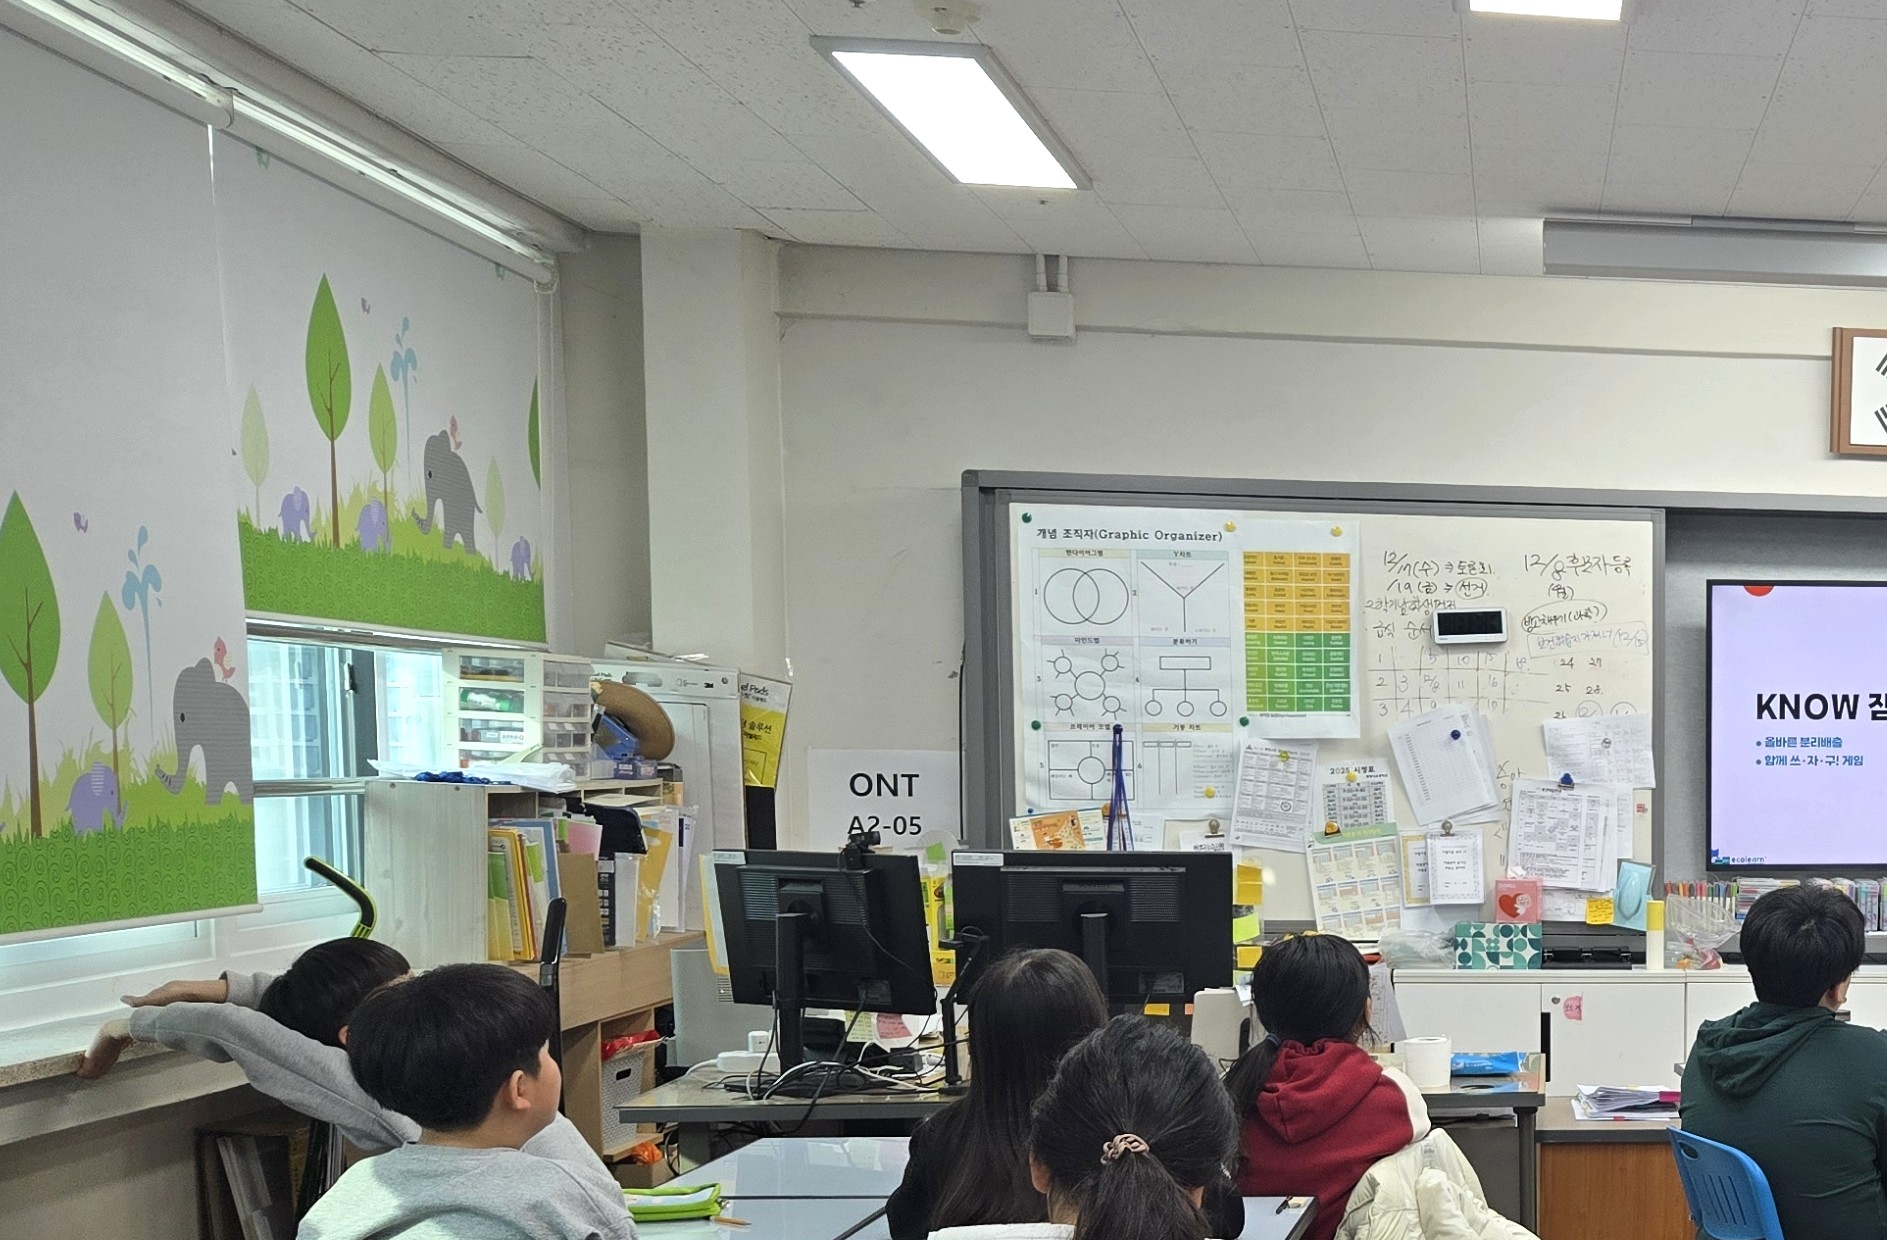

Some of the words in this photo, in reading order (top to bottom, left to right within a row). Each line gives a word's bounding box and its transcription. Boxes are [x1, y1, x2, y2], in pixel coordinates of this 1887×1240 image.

[1036, 528, 1057, 540] 개념
[1063, 528, 1149, 541] 조직자(Graphic
[1154, 530, 1223, 542] Organizer)
[1756, 693, 1860, 720] KNOW
[749, 719, 772, 735] 솔루션
[1764, 736, 1798, 748] 올바른
[1800, 736, 1843, 748] 분리배출
[1764, 755, 1787, 767] 함께
[1842, 755, 1864, 767] 게임
[849, 772, 920, 797] ONT
[847, 815, 922, 836] A2-05
[1731, 856, 1765, 864] ecolearn
